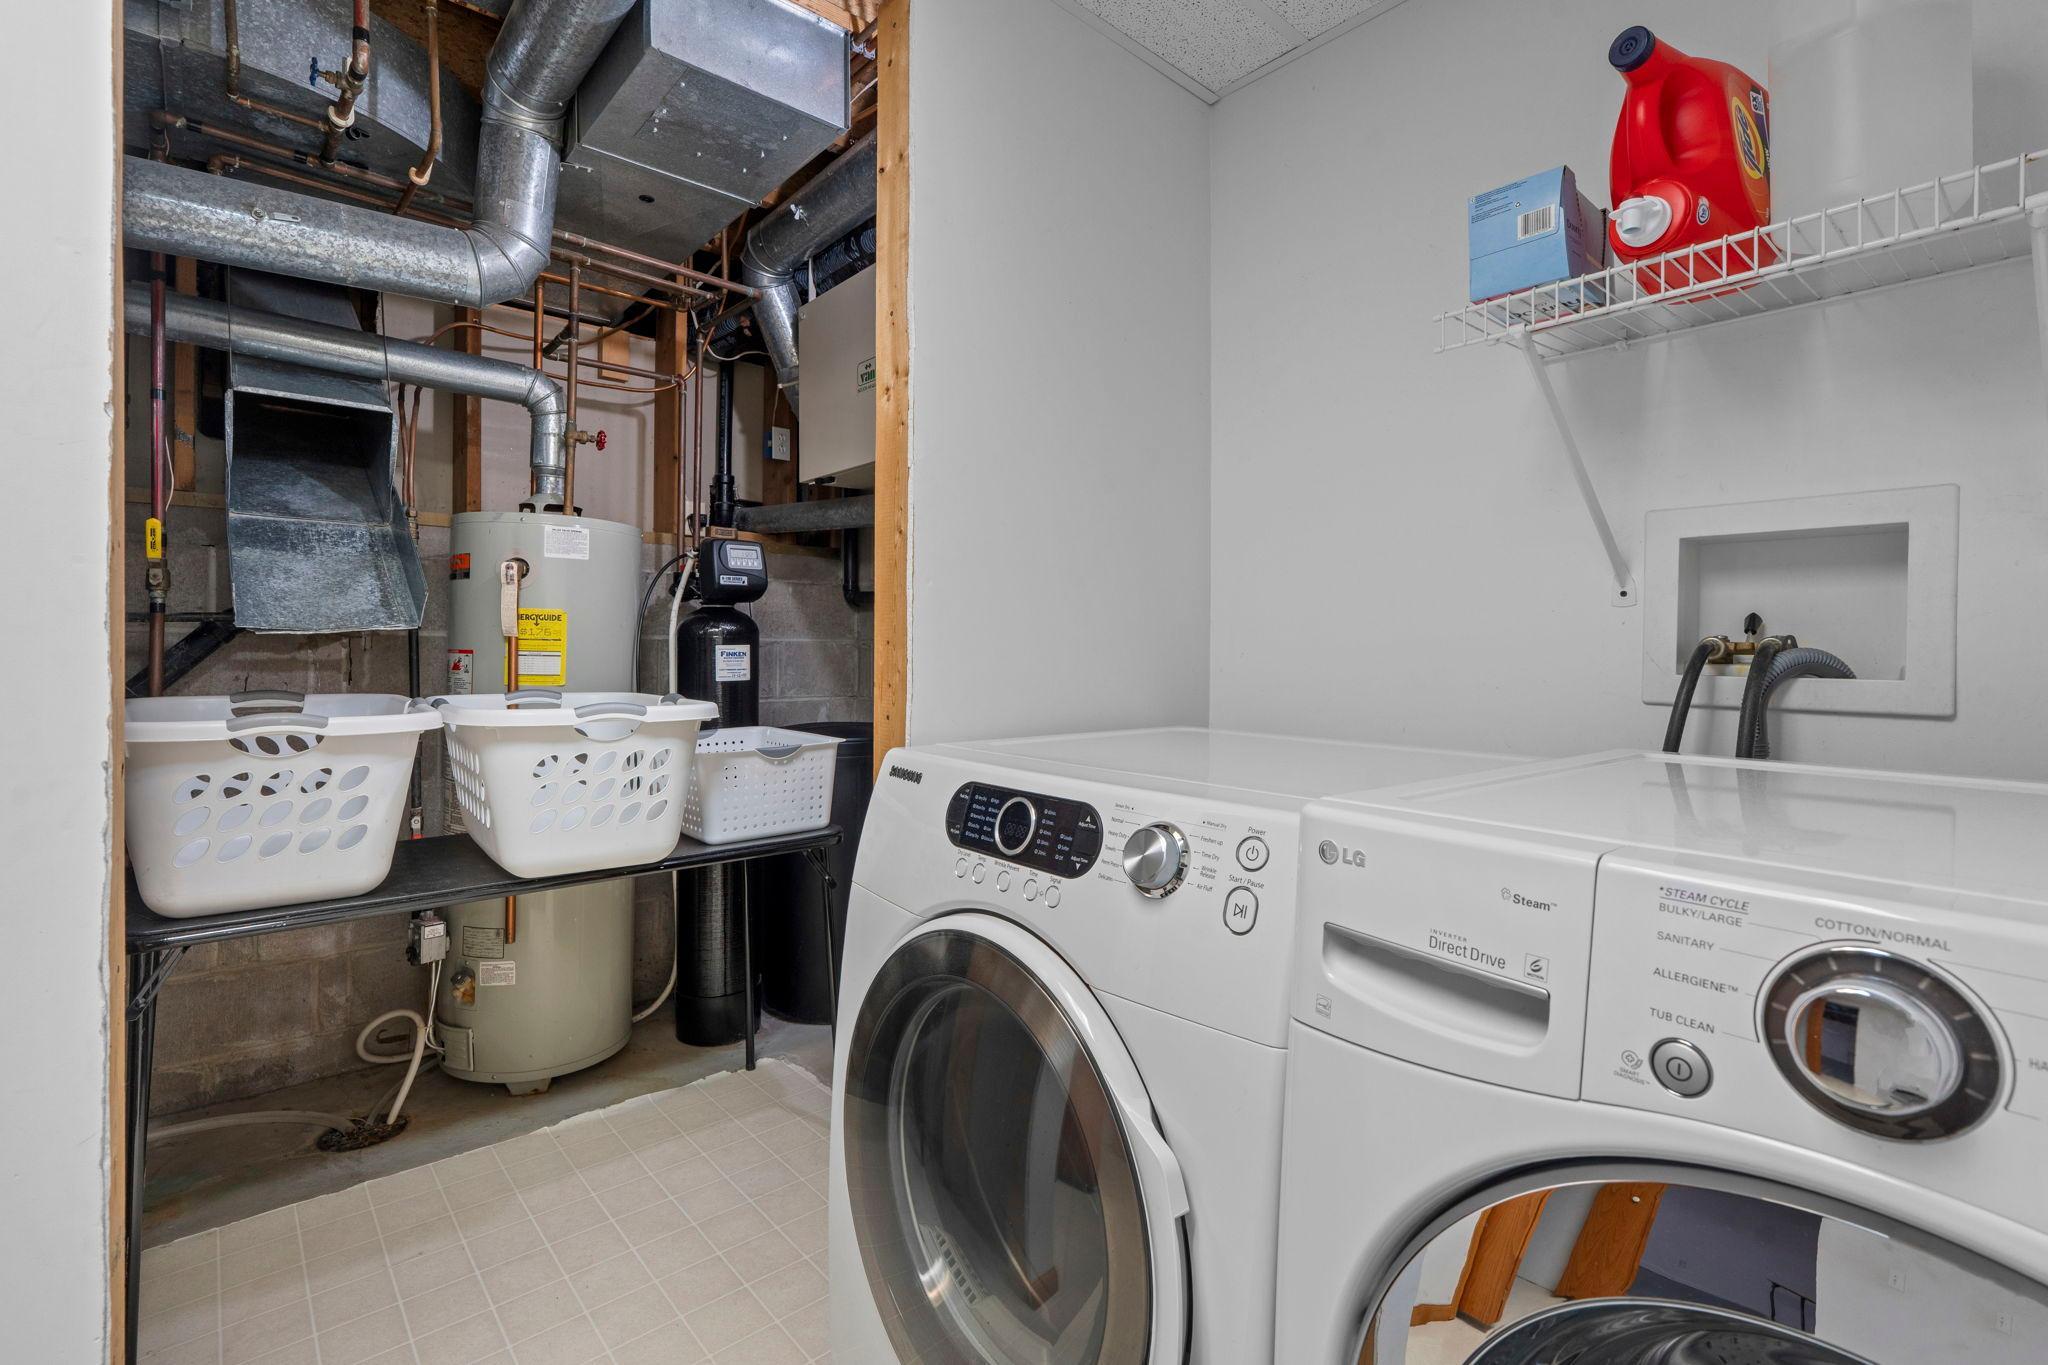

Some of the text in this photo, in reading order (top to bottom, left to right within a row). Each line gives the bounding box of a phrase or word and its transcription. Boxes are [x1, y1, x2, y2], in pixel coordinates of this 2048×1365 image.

[517, 613, 563, 622] ERGYGUIDE
[1247, 826, 1267, 836] Power
[1201, 850, 1220, 861] Time Dry
[1342, 847, 1366, 868] LG
[1228, 874, 1243, 884] Start
[1247, 878, 1265, 889] Pause
[1709, 895, 1751, 912] CYCLE
[1658, 902, 1743, 928] BULKY/LARGE
[1429, 928, 1468, 943] INVERTER
[1656, 930, 1716, 952] SANITARY
[1814, 916, 1952, 953] COTTON/NORMAL
[1429, 935, 1506, 970] Direct Drive
[1649, 1006, 1716, 1035] TUB CLEAN
